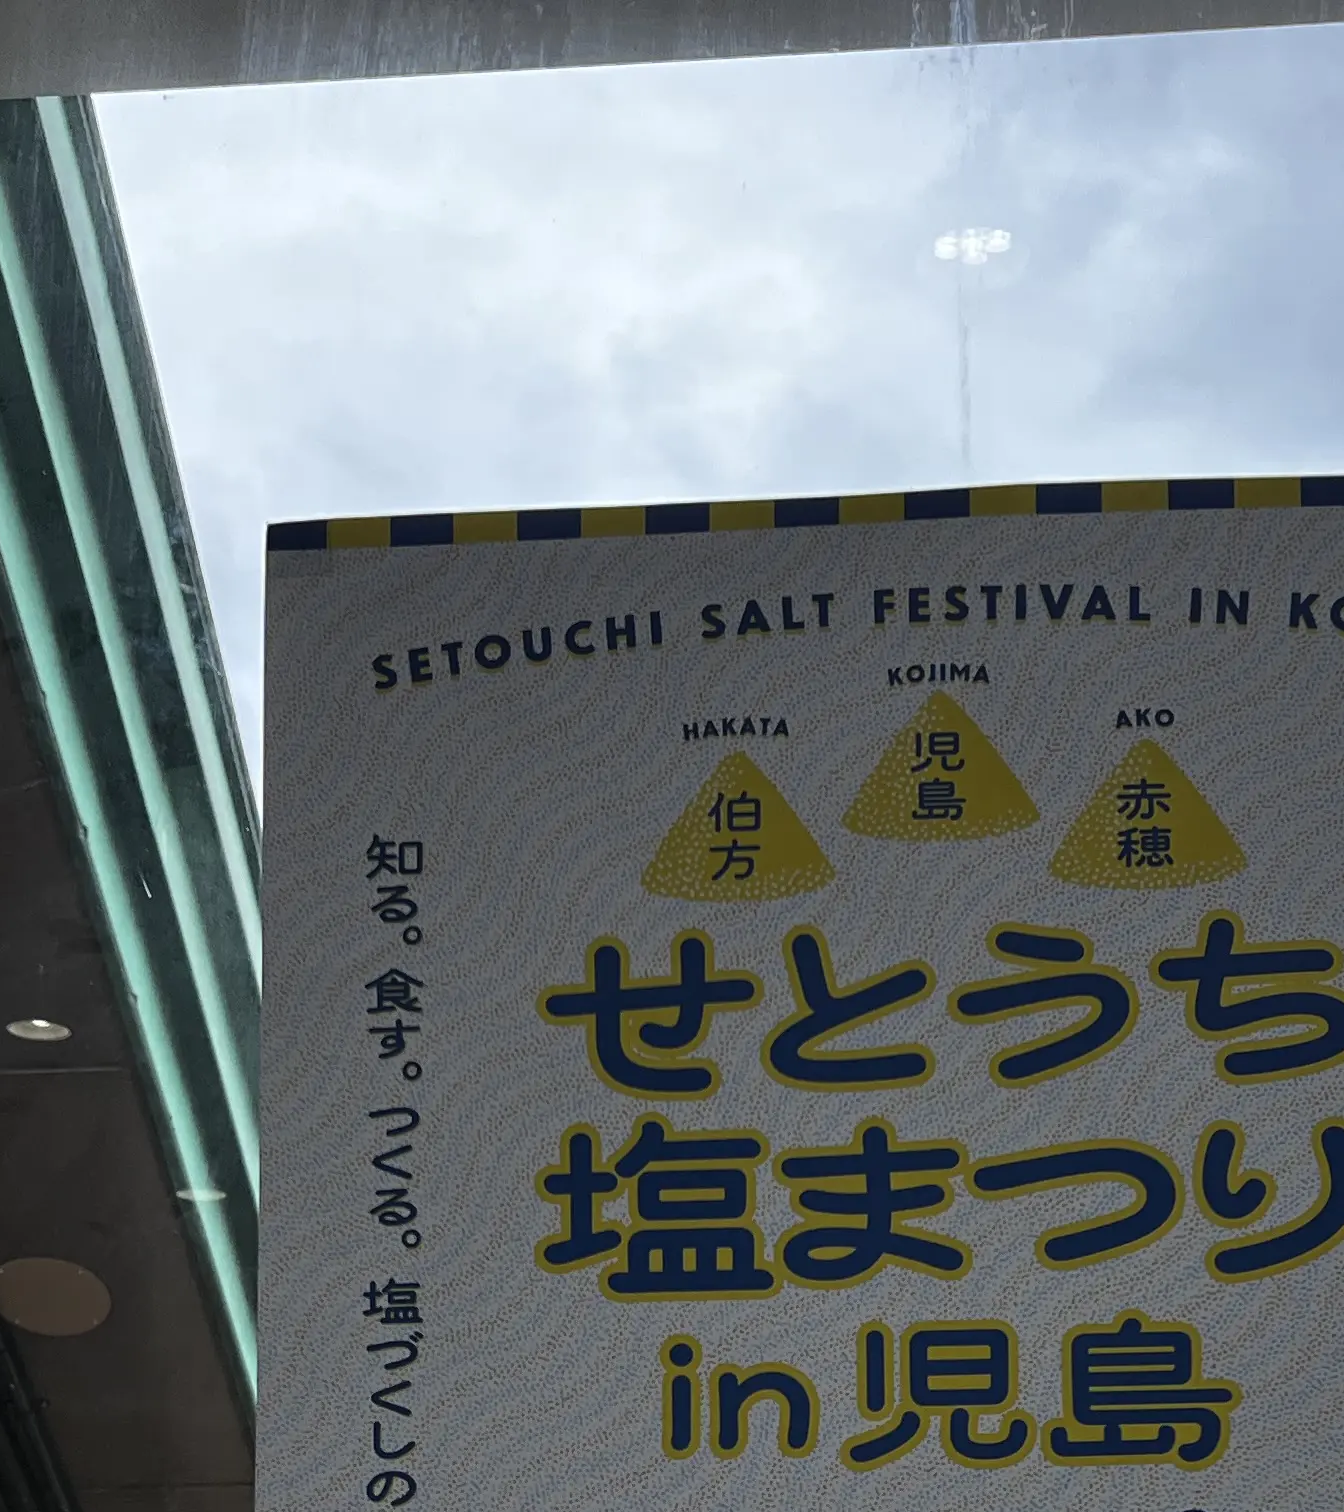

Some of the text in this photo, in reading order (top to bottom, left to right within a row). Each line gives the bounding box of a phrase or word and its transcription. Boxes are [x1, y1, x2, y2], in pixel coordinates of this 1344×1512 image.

[371, 610, 664, 690] SETOUCHI
[700, 592, 836, 640] SALT
[873, 583, 1152, 625] FESTIVAL
[1189, 588, 1250, 626] IN
[886, 662, 991, 688] KOJIMA
[682, 716, 790, 742] HAKATA
[1115, 707, 1176, 730] AKO
[910, 731, 967, 823] 児島
[707, 790, 763, 882] 伯方
[1116, 778, 1175, 870] 赤穂
